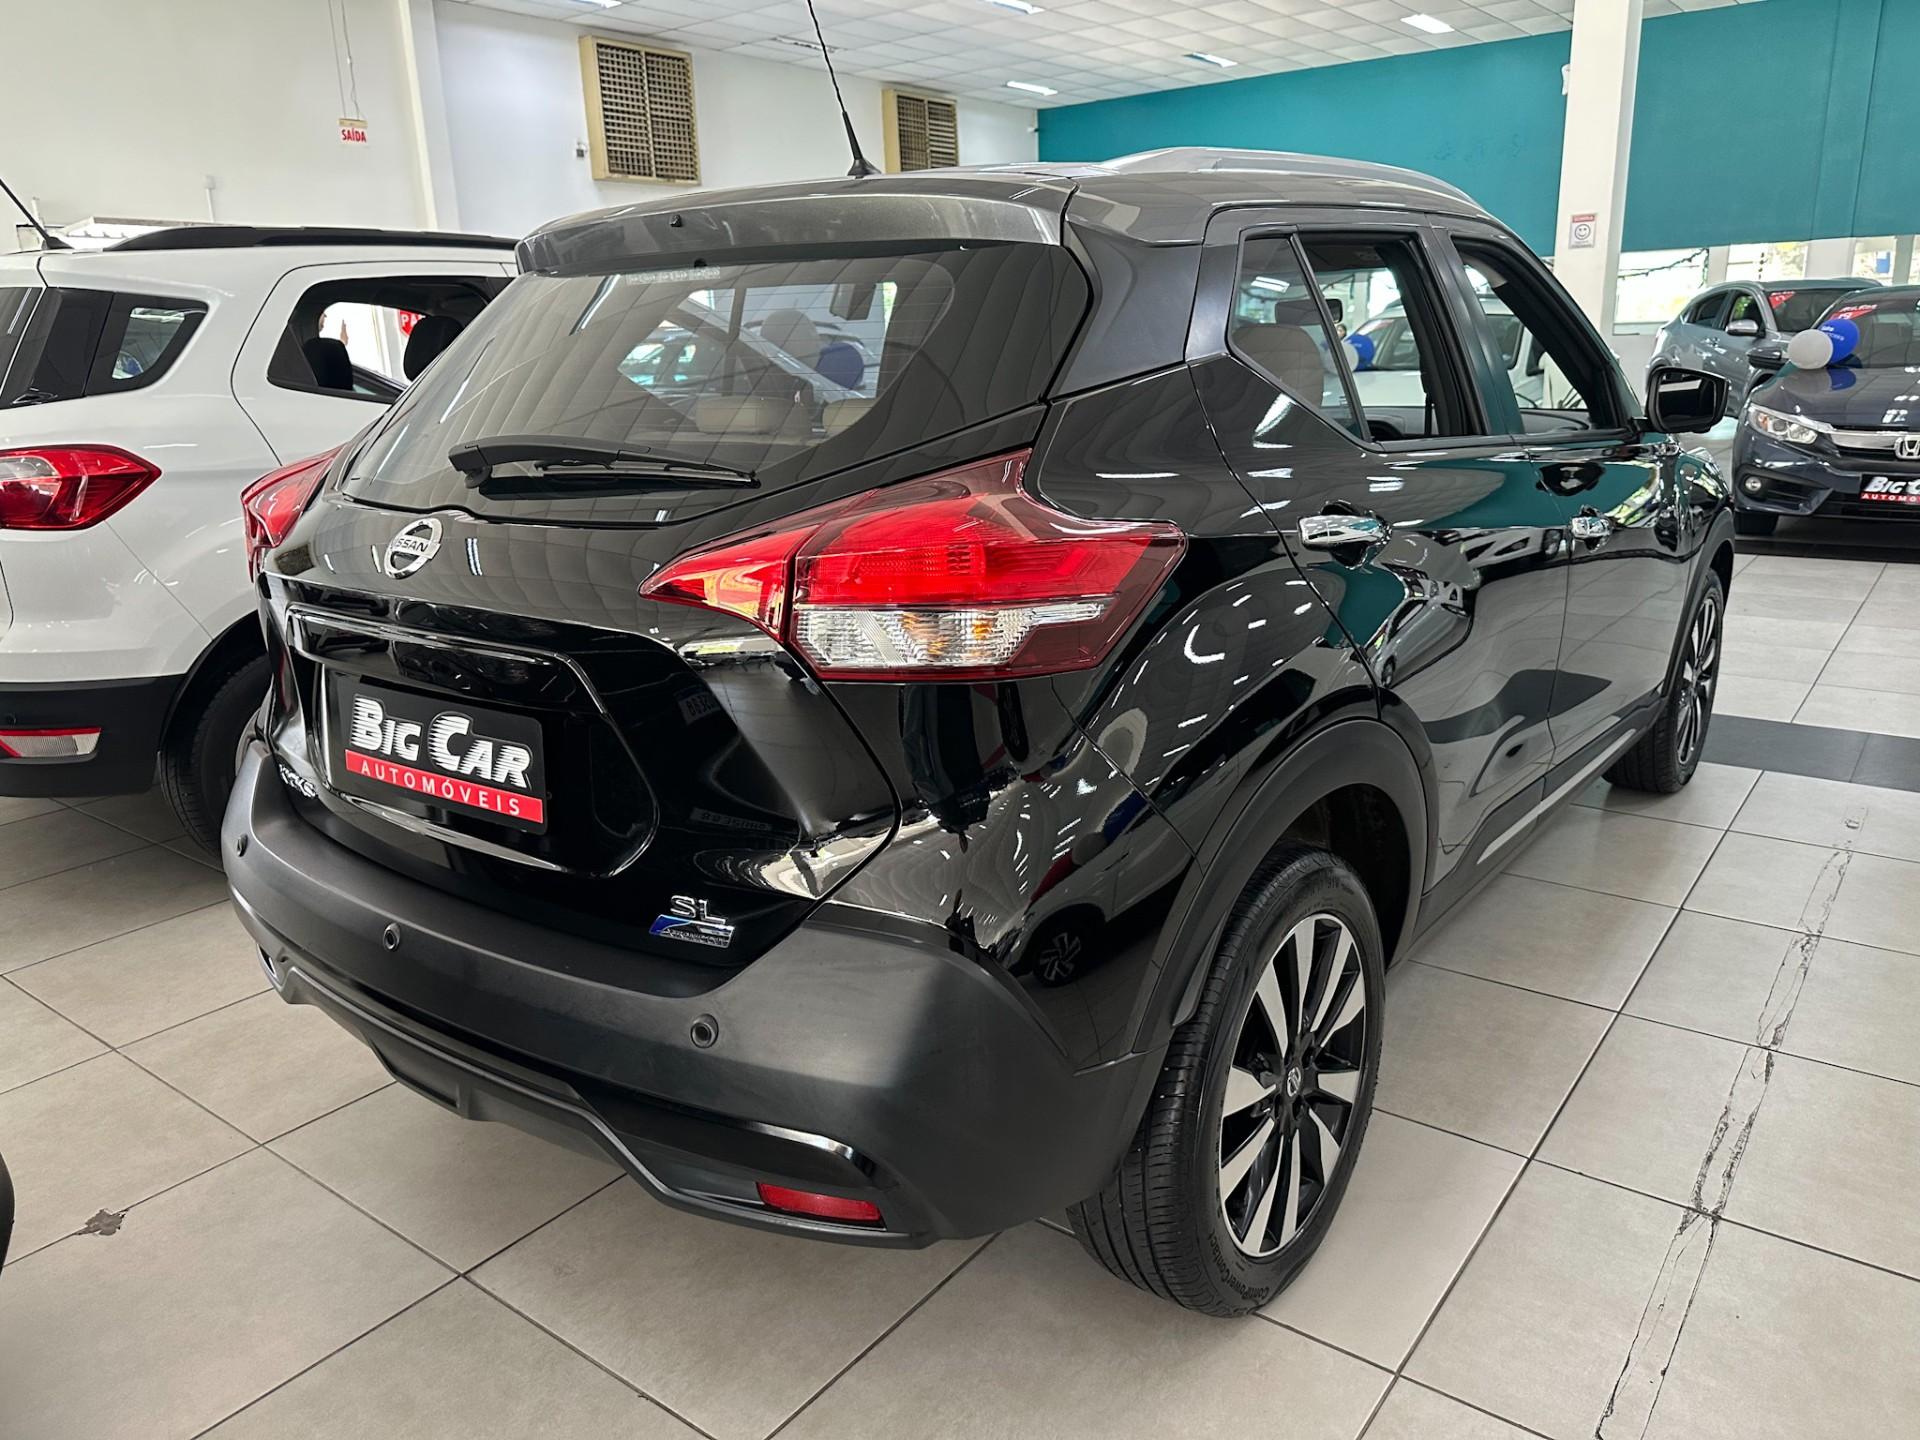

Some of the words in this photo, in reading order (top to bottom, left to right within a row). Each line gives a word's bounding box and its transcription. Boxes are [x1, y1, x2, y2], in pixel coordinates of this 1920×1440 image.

[341, 128, 367, 142] SAÍDA
[401, 313, 423, 327] PA
[1864, 476, 1907, 494] BIG
[350, 697, 423, 762] BIG
[428, 714, 532, 789] CAR
[361, 759, 521, 816] AUTOMÓVEIS
[670, 895, 726, 925] SL
